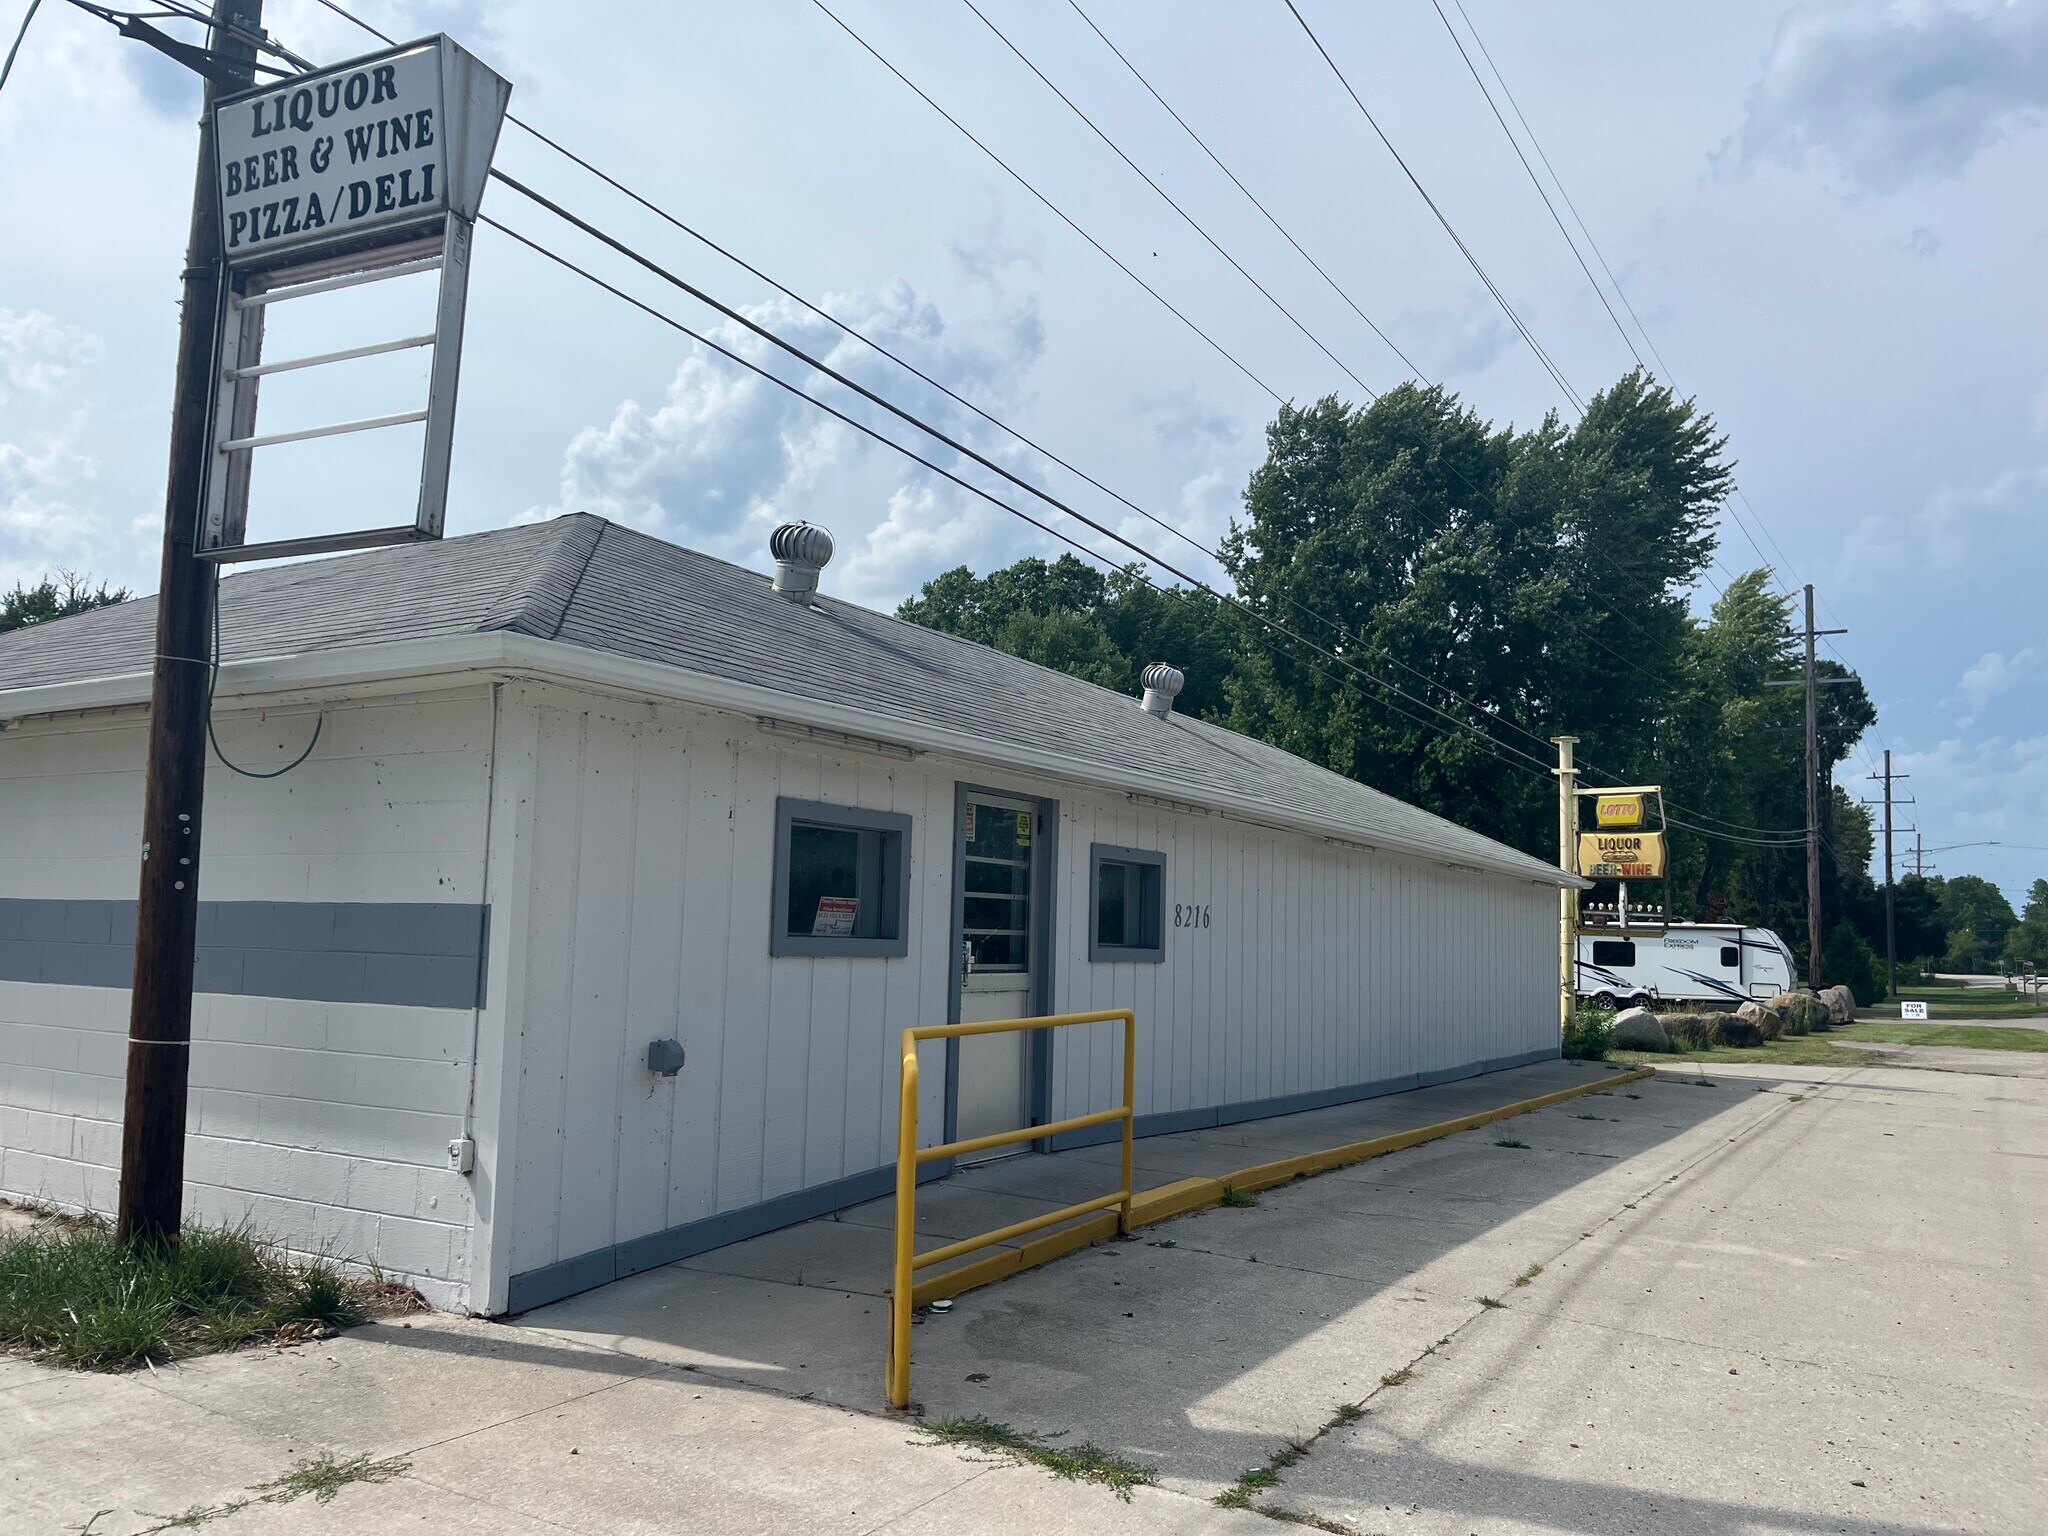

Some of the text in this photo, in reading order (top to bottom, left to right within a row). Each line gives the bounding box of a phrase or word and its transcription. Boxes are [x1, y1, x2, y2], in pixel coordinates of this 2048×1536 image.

[251, 64, 398, 138] LIQUOR
[225, 108, 434, 197] BEER & WINE
[228, 163, 436, 248] PIZZA/DELI
[1600, 803, 1637, 816] LOTTO
[1598, 837, 1642, 851] LIQUOR
[1589, 863, 1653, 876] BEER-WINE
[1174, 903, 1210, 929] 8216
